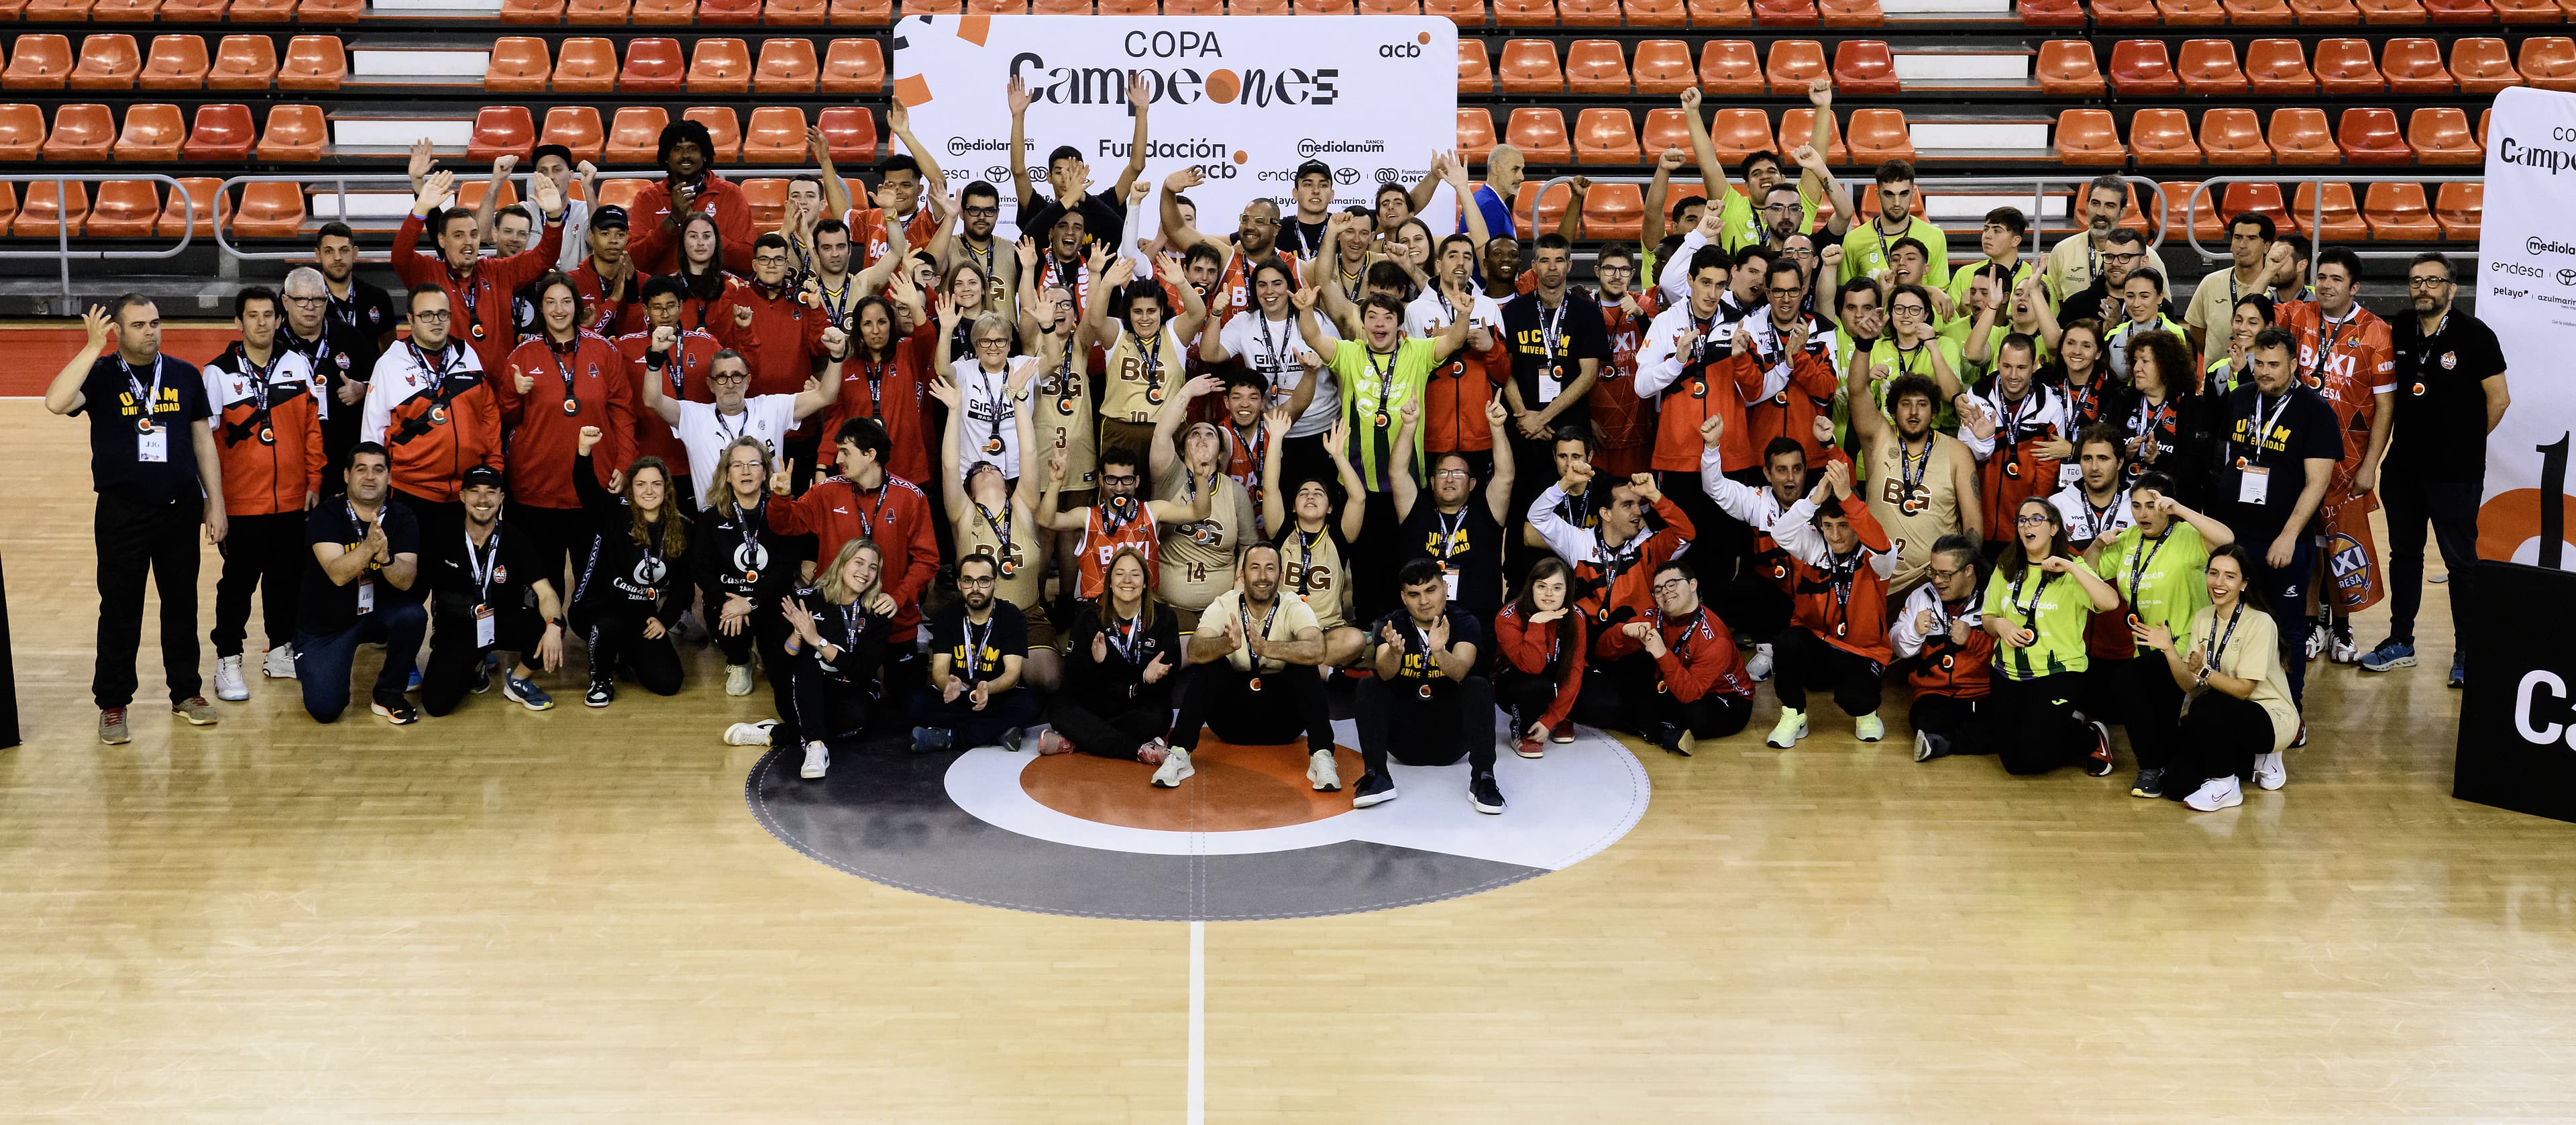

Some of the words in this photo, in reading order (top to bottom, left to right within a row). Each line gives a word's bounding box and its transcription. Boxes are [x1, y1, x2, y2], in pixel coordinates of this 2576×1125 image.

[1124, 30, 1223, 59] COPA
[1379, 41, 1421, 58] acb
[1009, 52, 1339, 117] Campeones
[2553, 127, 2576, 142] CO
[951, 138, 1034, 152] mediolam
[1300, 140, 1385, 153] mediolanum
[941, 168, 969, 179] esa
[1191, 161, 1237, 179] acb
[1401, 175, 1423, 183] ONC
[2529, 241, 2576, 255] mediola
[2491, 262, 2544, 278] endesa
[2493, 287, 2523, 299] pelayo
[2538, 295, 2576, 306] azulmarin
[1517, 329, 1570, 348] UCM
[1120, 356, 1167, 383] BG
[1130, 411, 1149, 423] 10
[1055, 426, 1067, 449] 3
[1882, 476, 1932, 512] BG
[1185, 561, 1207, 584] 14
[1283, 560, 1332, 591] BG
